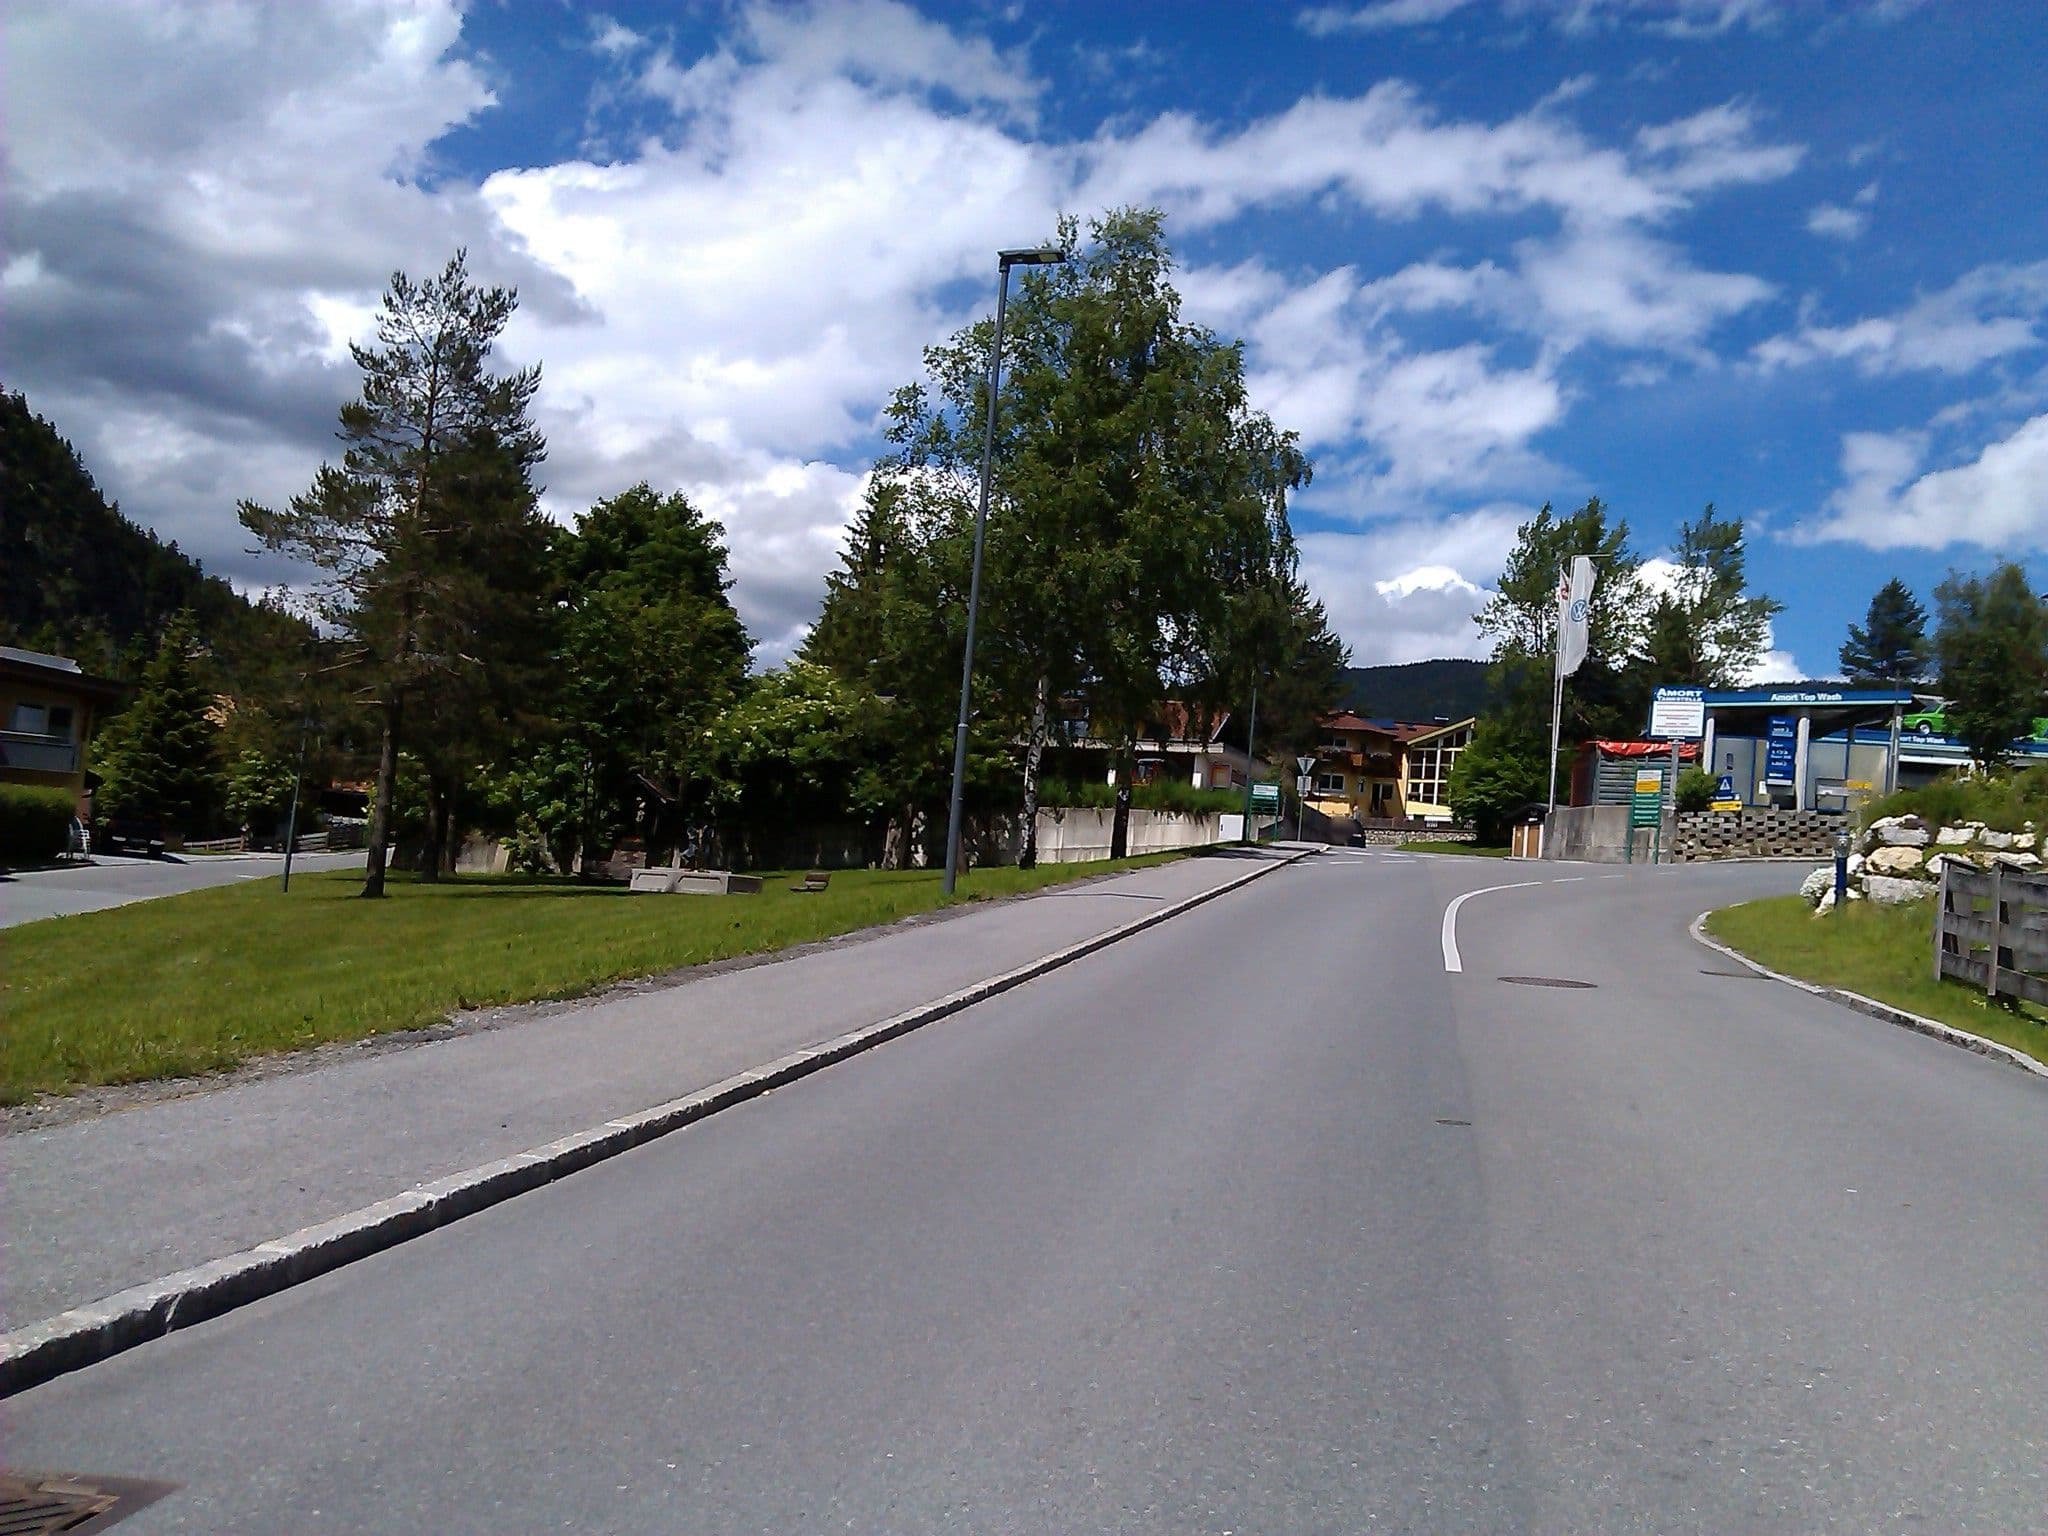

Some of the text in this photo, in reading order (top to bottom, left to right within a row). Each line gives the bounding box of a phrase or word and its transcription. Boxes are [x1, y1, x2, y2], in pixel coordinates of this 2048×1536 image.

[1657, 688, 1703, 697] AMORT
[1771, 693, 1842, 702] Amort Top Wash
